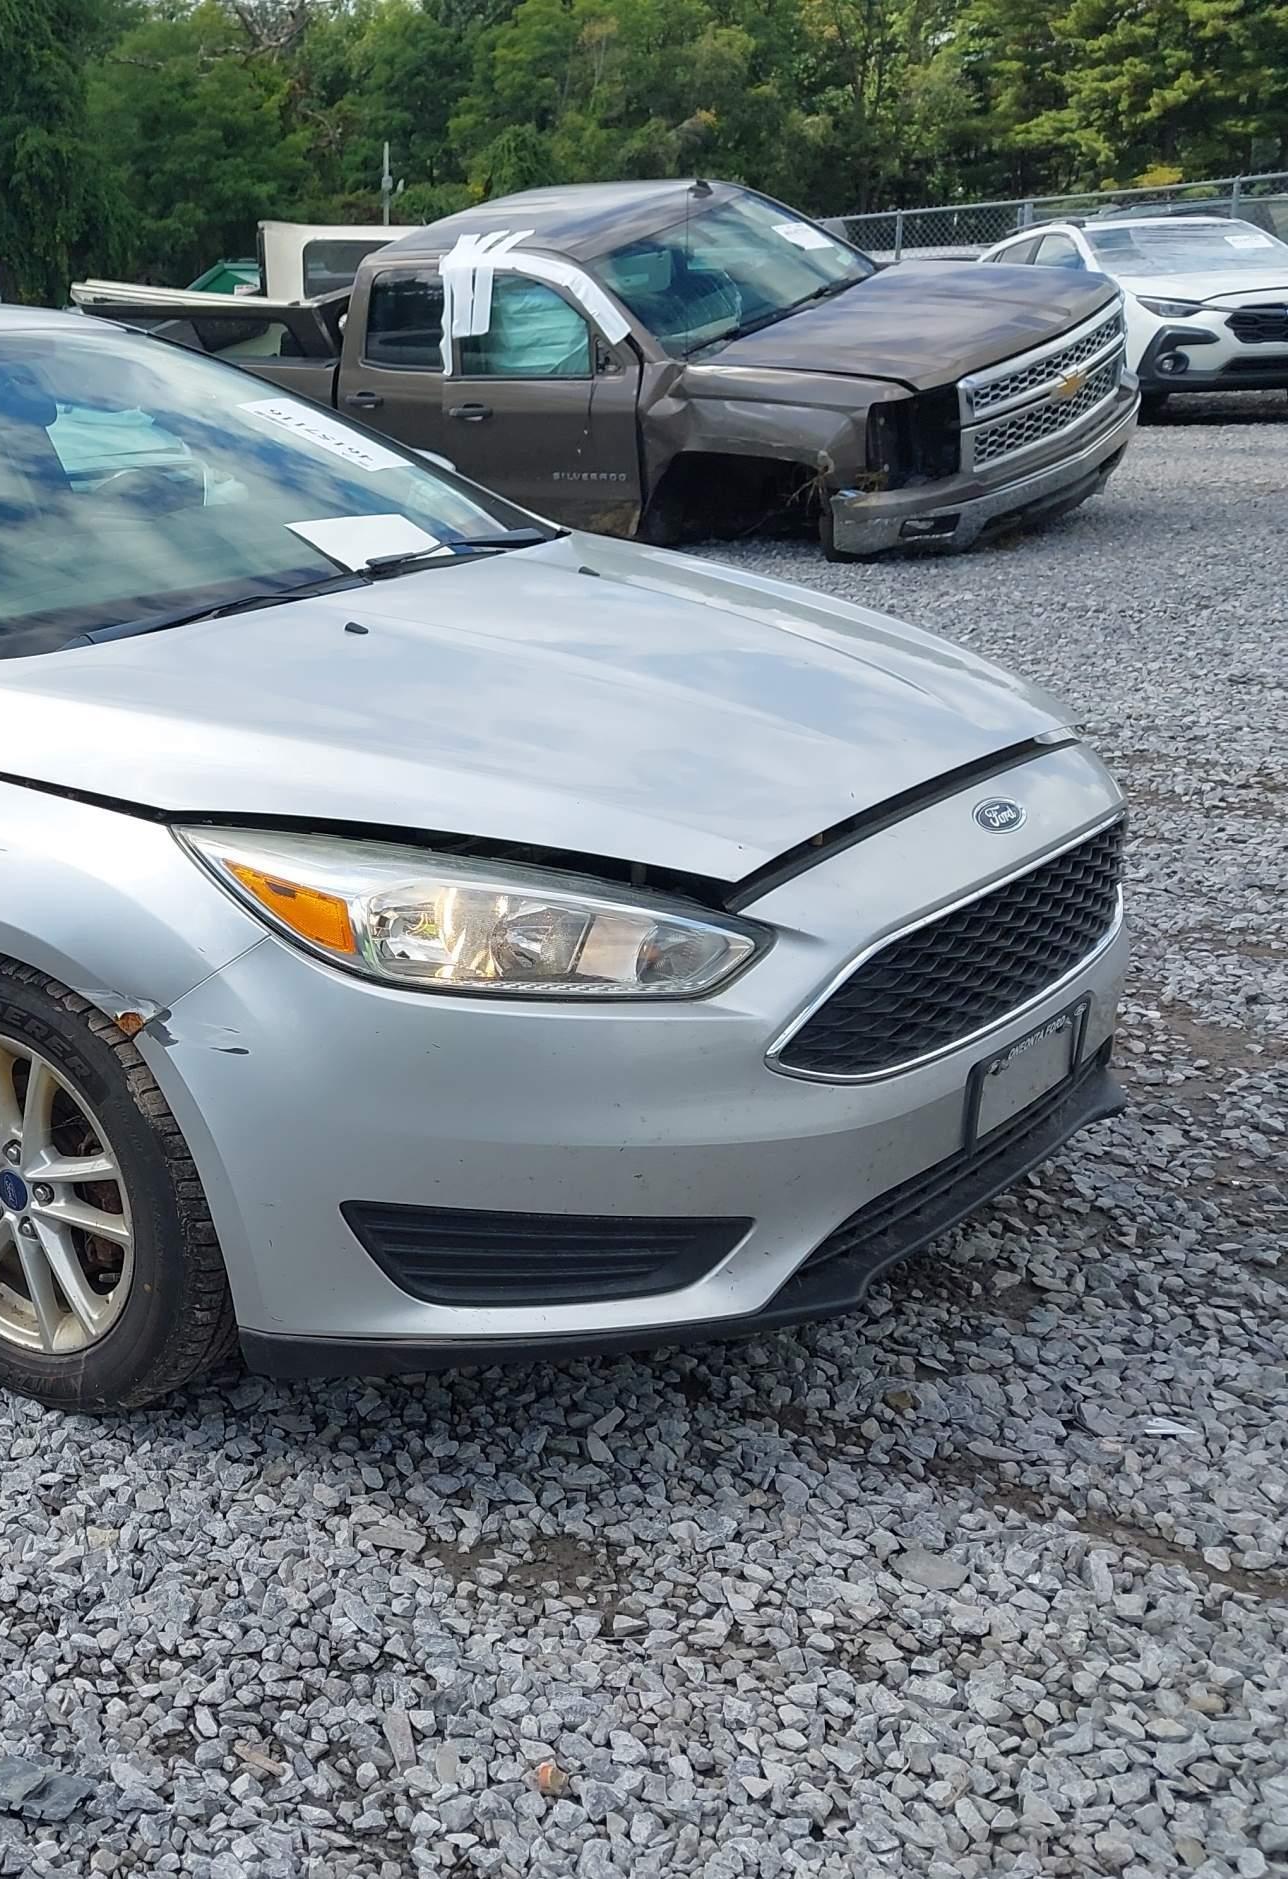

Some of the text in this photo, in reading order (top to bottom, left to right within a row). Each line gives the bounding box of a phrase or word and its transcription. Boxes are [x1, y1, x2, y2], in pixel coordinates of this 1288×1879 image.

[553, 472, 627, 481] SILVERADO
[985, 804, 1017, 827] Ford
[1008, 1014, 1066, 1060] ONEONTA FORD
